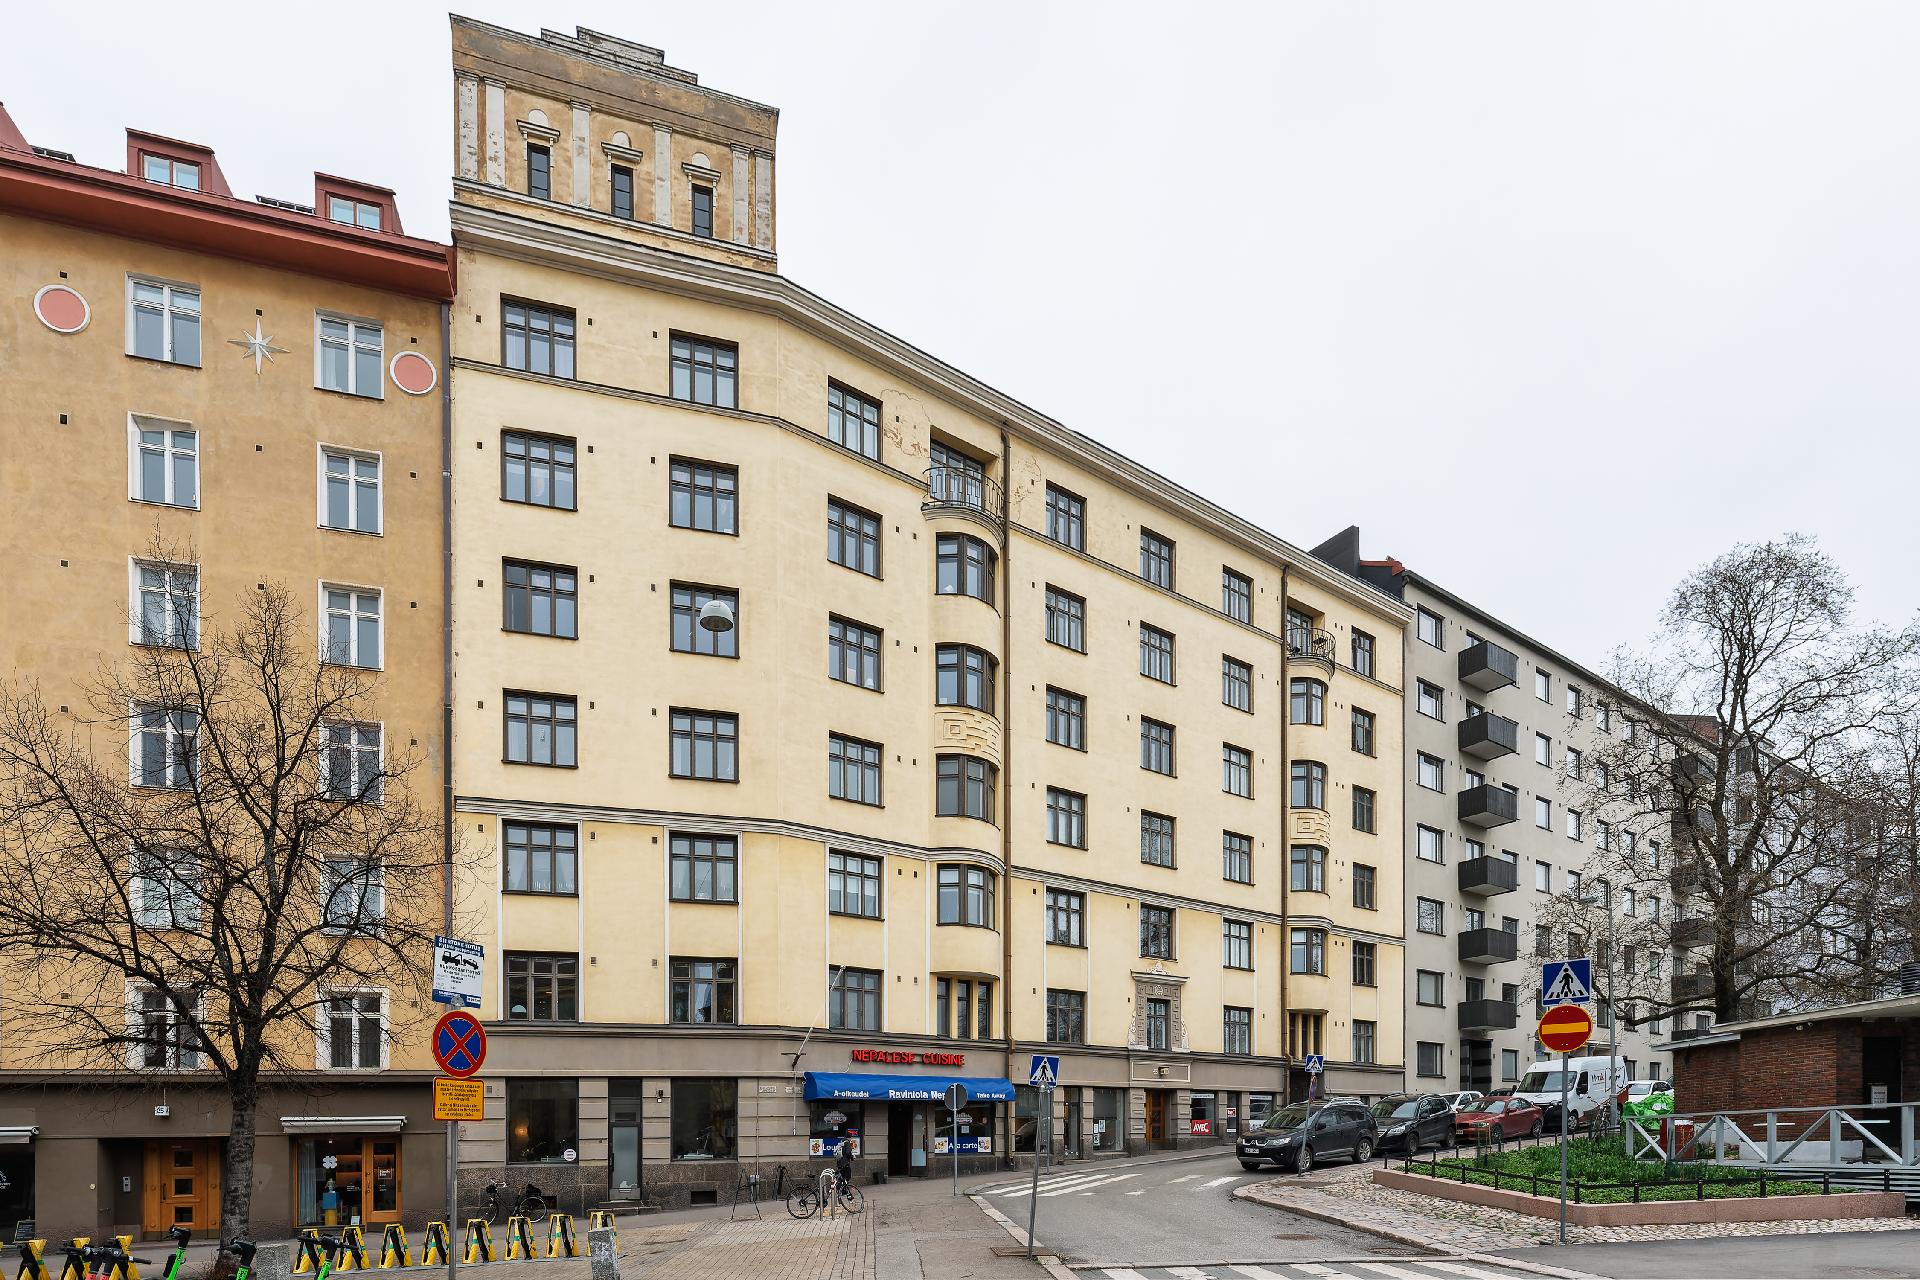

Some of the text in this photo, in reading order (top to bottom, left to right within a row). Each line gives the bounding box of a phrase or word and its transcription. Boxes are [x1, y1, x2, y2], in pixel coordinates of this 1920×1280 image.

[852, 1049, 965, 1067] NEPALESE CUISINE
[889, 1090, 929, 1100] Ravintola
